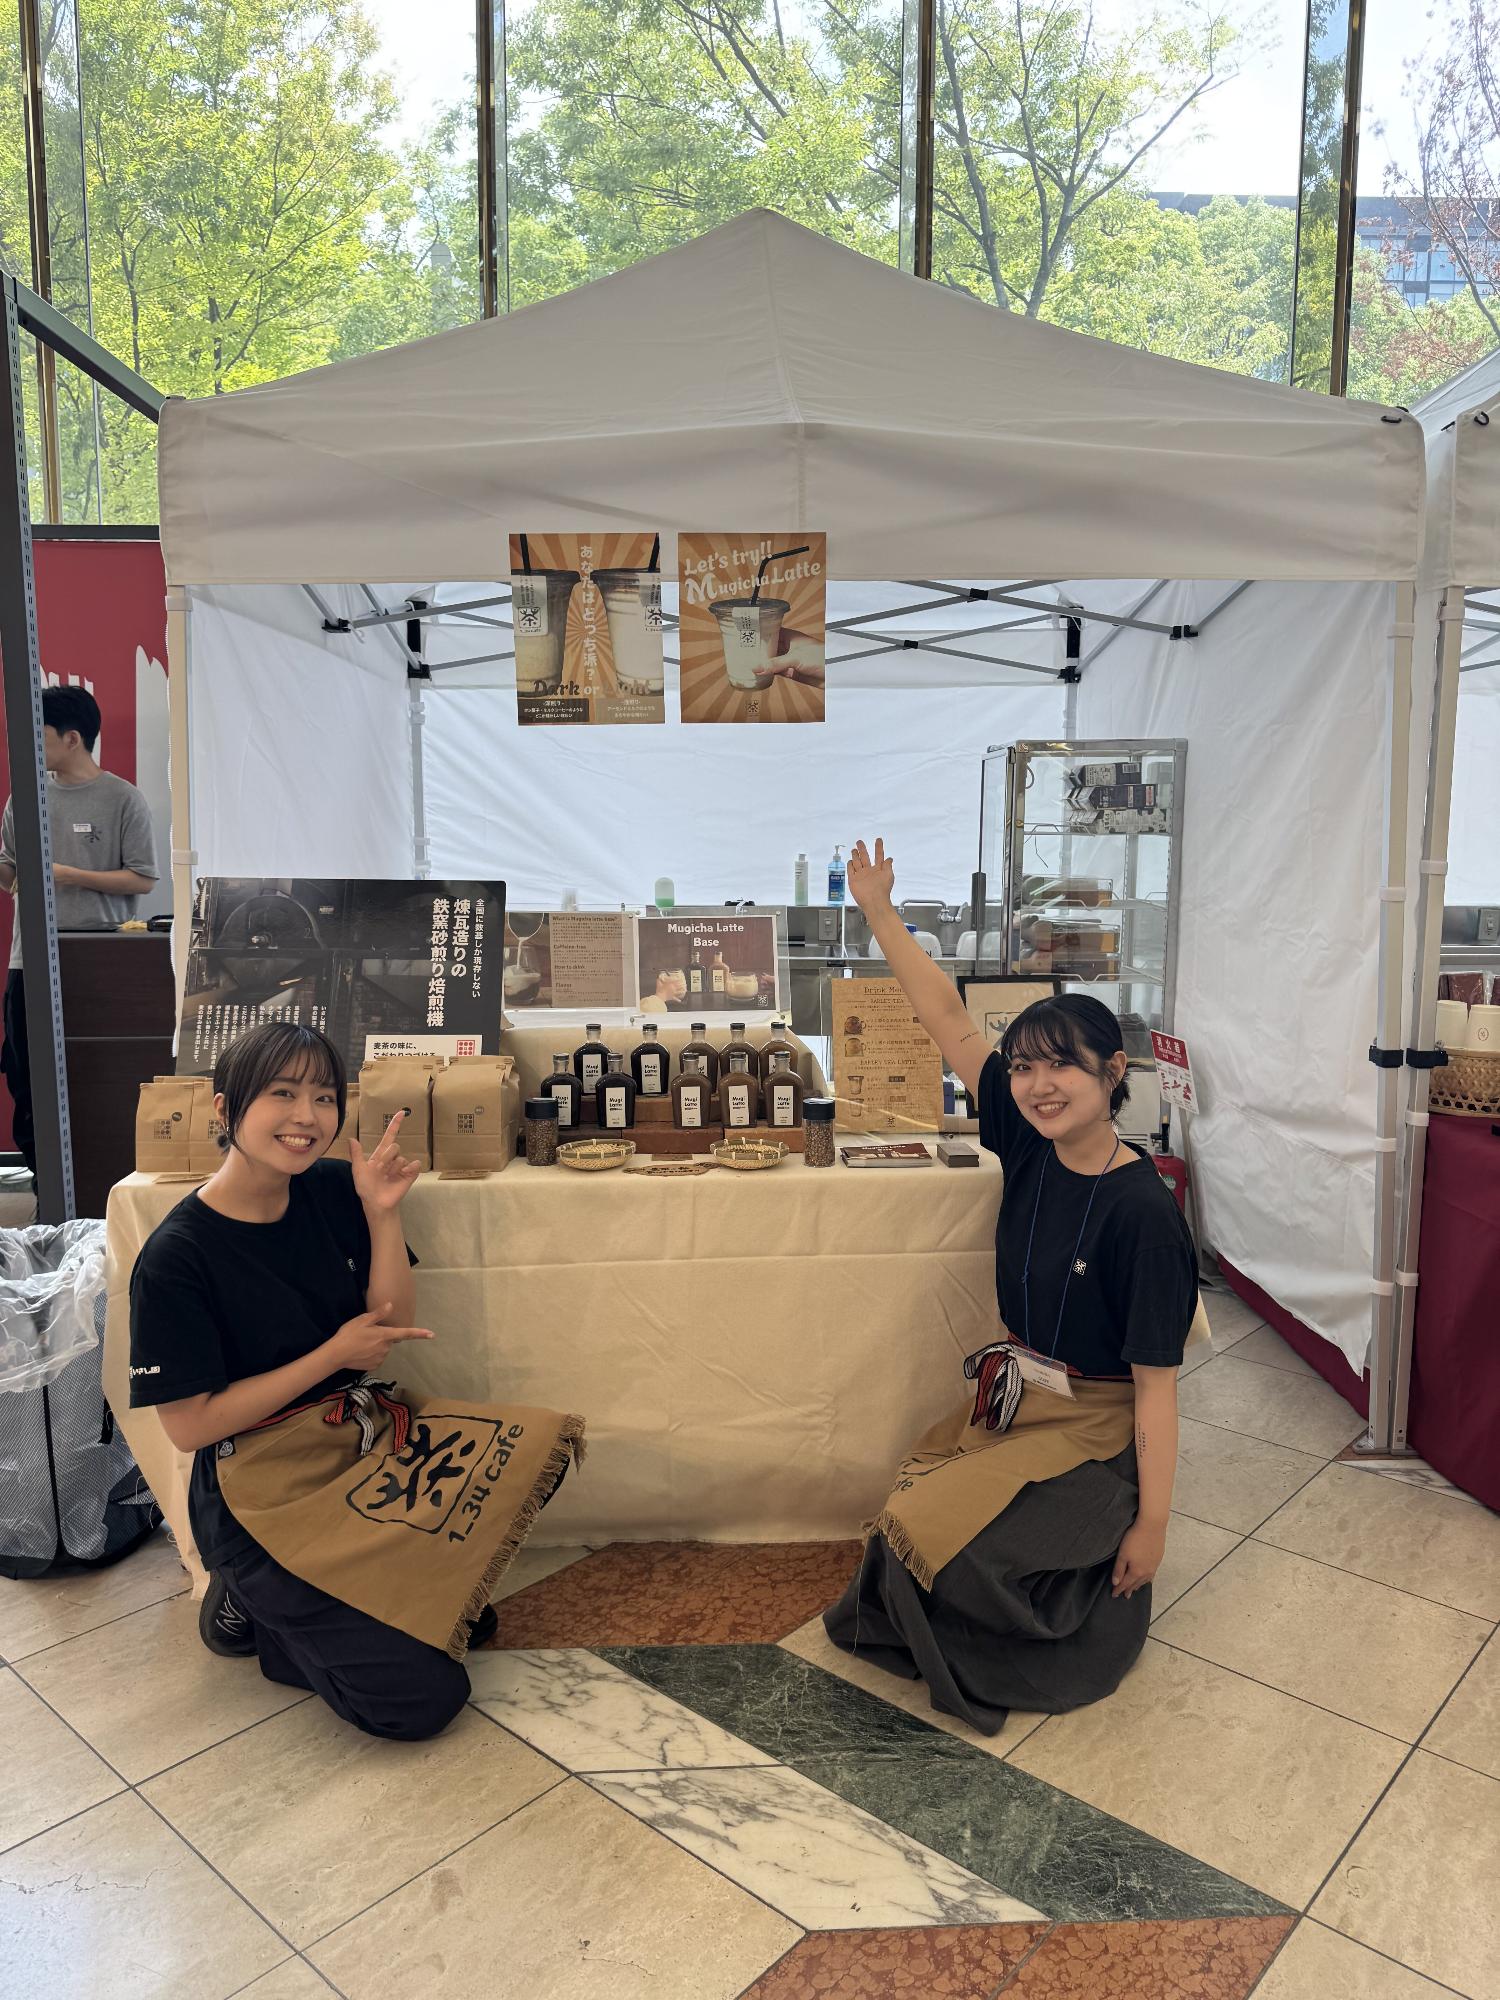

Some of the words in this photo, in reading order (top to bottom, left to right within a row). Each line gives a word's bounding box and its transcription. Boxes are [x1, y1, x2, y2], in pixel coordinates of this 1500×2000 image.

[684, 552, 729, 576] Let's
[733, 540, 773, 567] try!!
[684, 571, 770, 605] Mugicha
[771, 562, 822, 585] Latte
[533, 680, 580, 697] Dark
[583, 685, 602, 696] or
[451, 898, 471, 977] 煉瓦造りの
[472, 898, 485, 998] 全国に数基しか現存しない
[668, 923, 714, 934] Mugicha
[716, 923, 744, 933] Latte
[693, 937, 719, 947] Base
[426, 898, 451, 1027] 鉄窯砂煎り焙煎機
[373, 1042, 417, 1050] 麦茶の味に、
[485, 1424, 524, 1482] cafe
